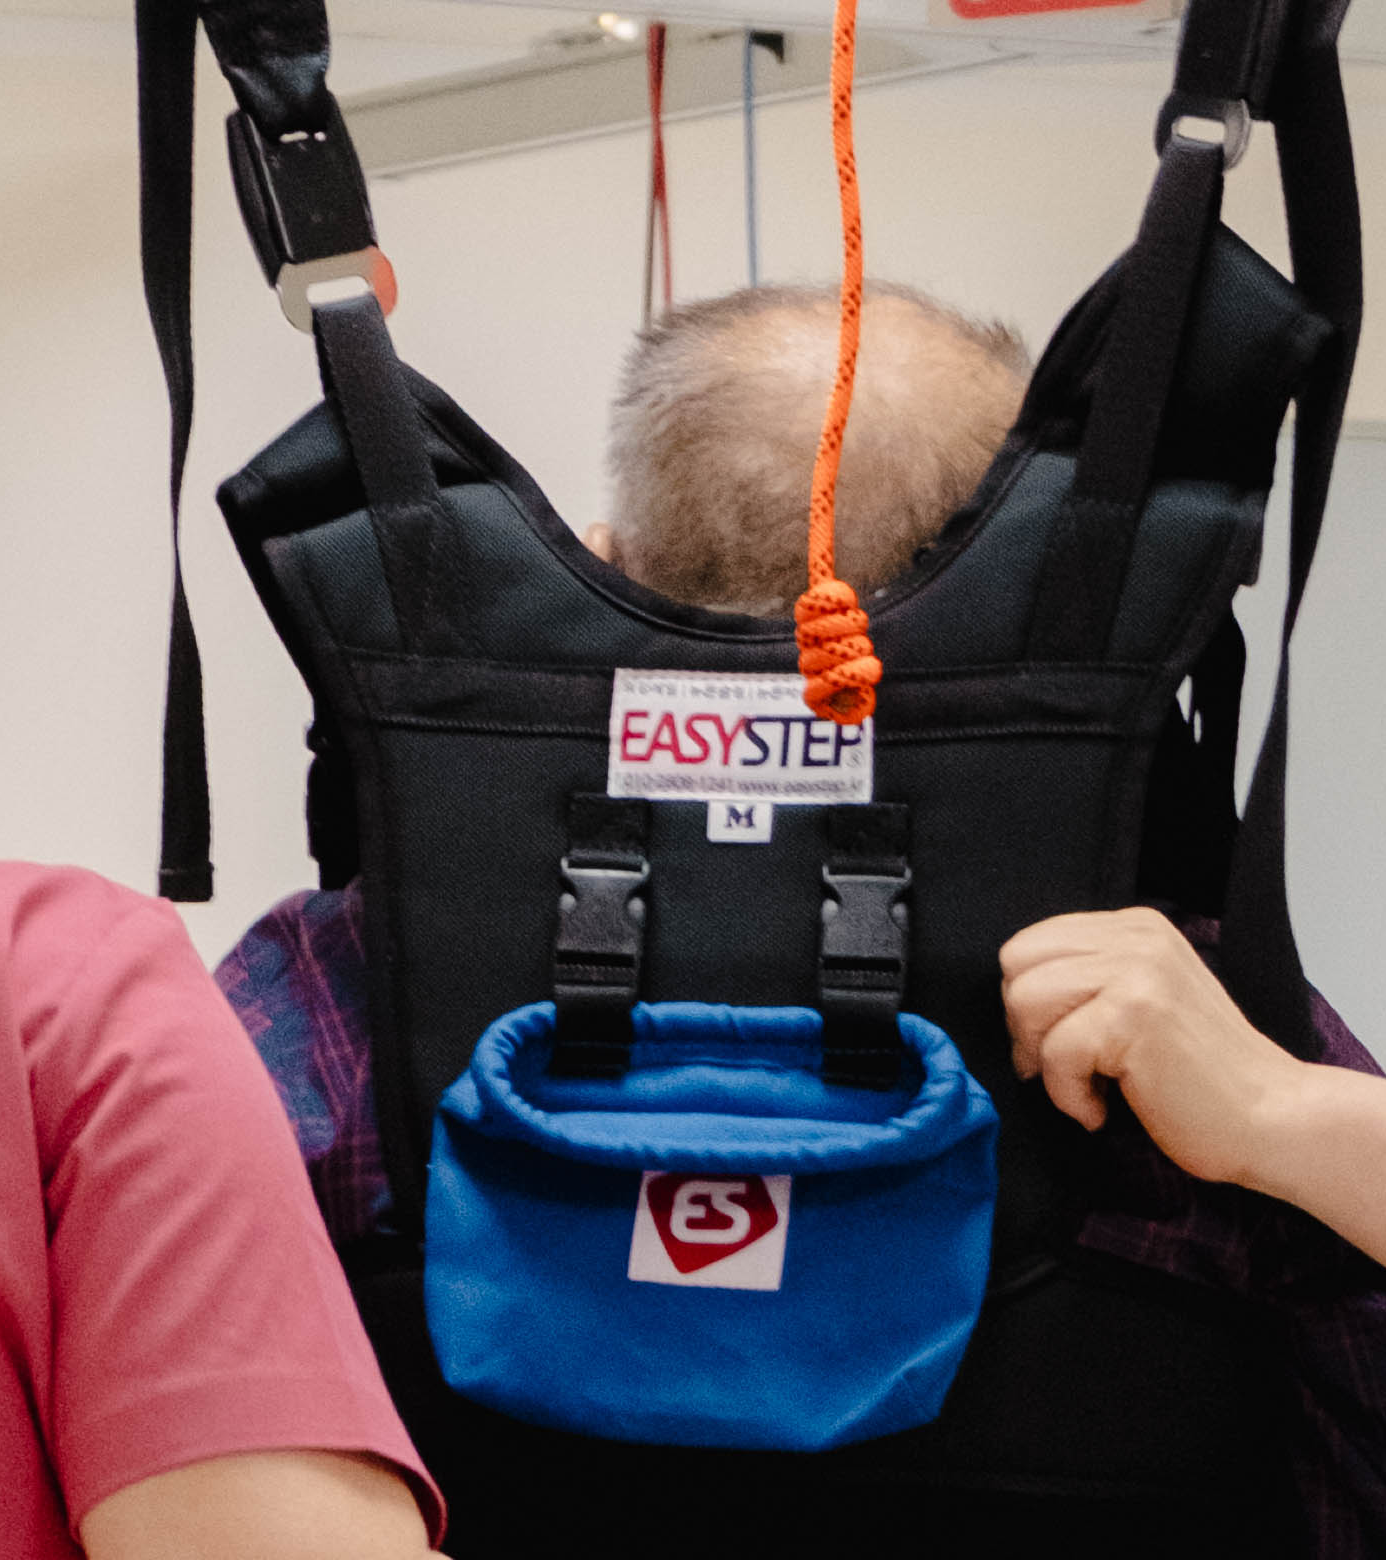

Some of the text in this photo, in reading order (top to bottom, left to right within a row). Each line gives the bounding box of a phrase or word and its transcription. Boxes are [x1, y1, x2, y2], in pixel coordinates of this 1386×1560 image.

[620, 710, 866, 768] EASYSTEP
[724, 805, 758, 830] M
[670, 1180, 751, 1245] ES
